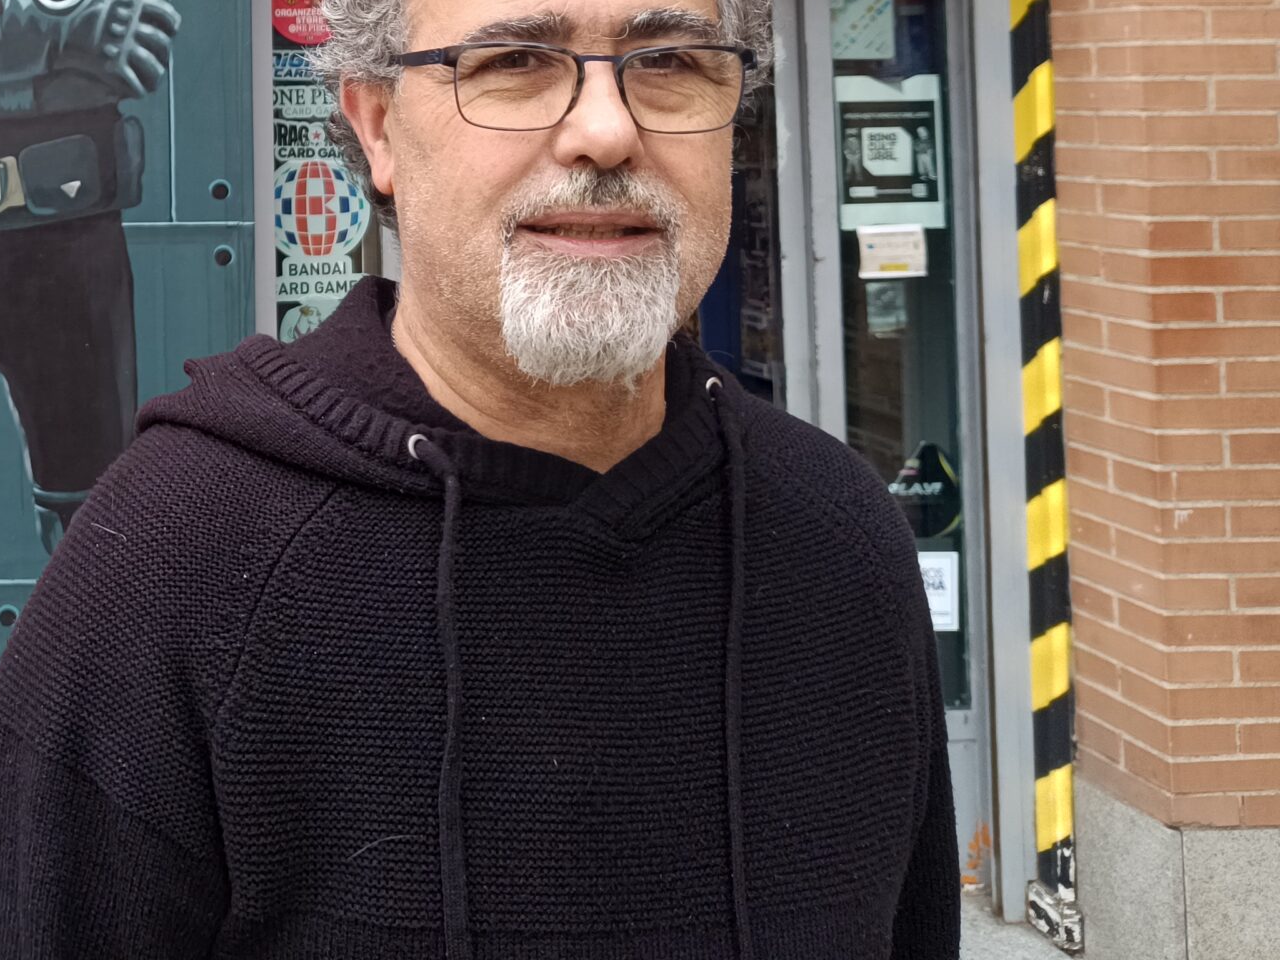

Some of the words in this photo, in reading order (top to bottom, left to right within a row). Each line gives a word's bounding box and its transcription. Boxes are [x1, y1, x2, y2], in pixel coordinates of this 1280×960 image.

[284, 107, 312, 117] CARD
[278, 147, 316, 158] CARD
[288, 261, 347, 277] BANDAI
[275, 281, 310, 296] ARD
